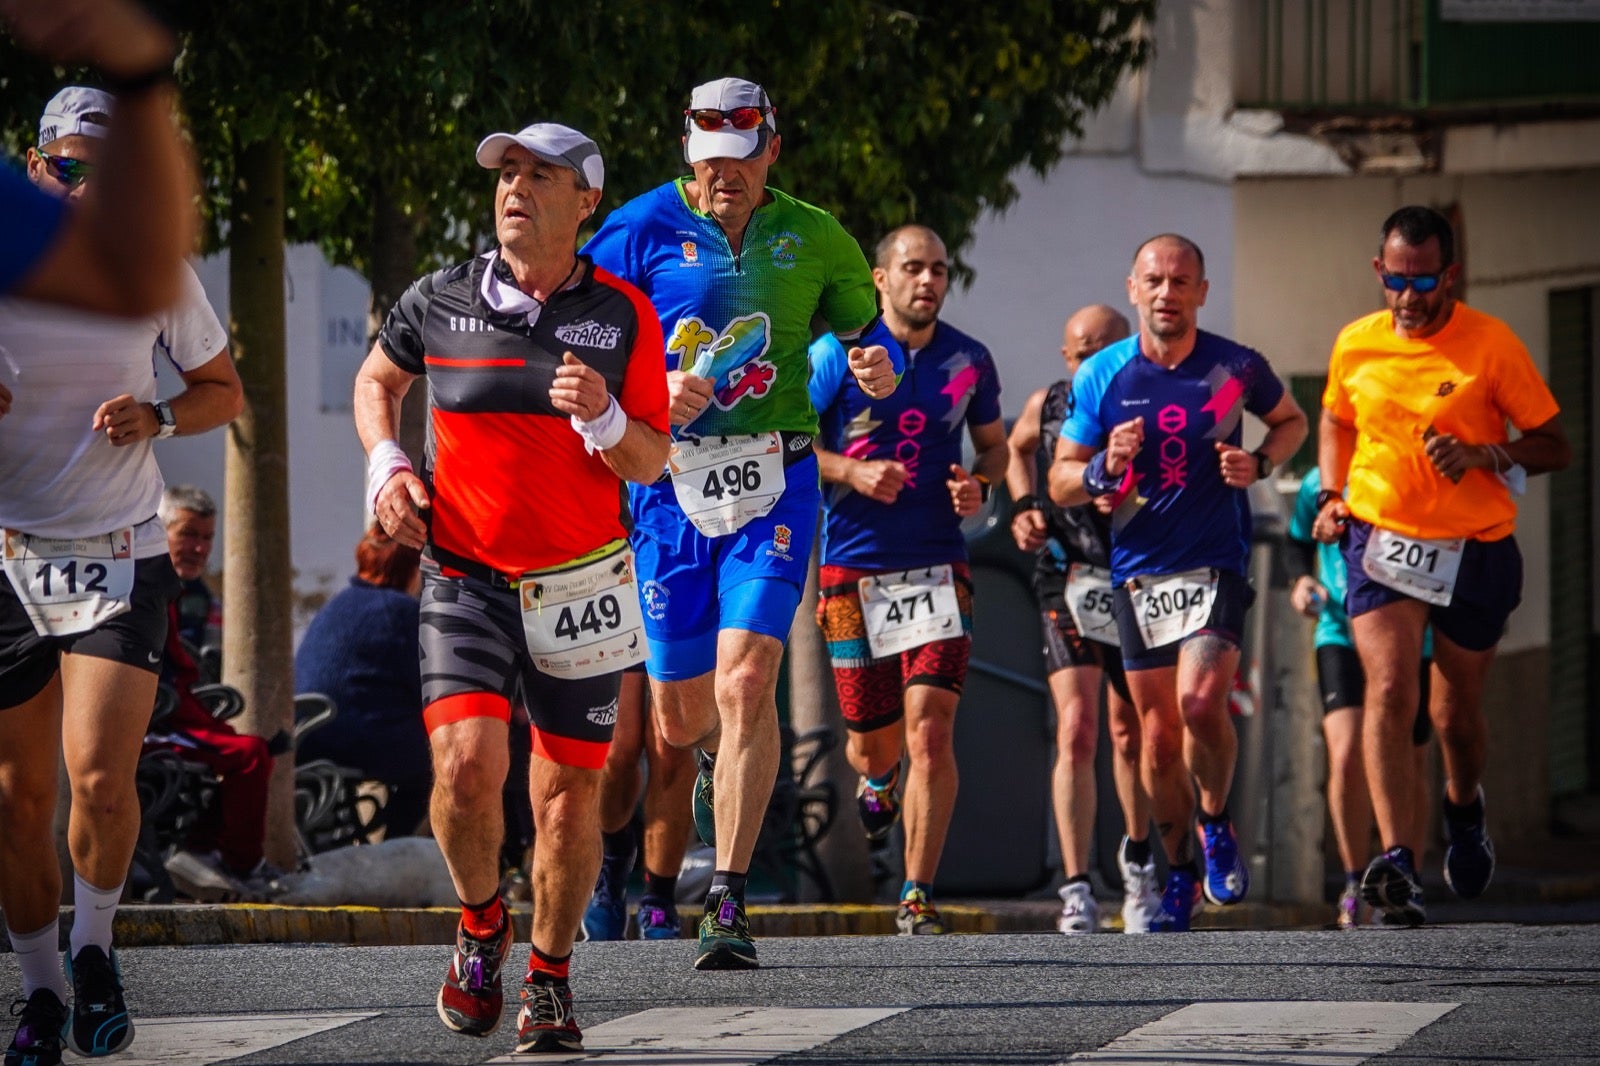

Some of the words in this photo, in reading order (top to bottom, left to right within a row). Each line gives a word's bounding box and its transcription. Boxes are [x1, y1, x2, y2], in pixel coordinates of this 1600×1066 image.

[561, 325, 617, 348] ATARFE
[702, 460, 762, 501] 496
[1386, 540, 1440, 573] 201
[35, 560, 108, 597] 112
[555, 594, 621, 641] 449
[886, 591, 935, 624] 471
[1145, 586, 1205, 619] 3004
